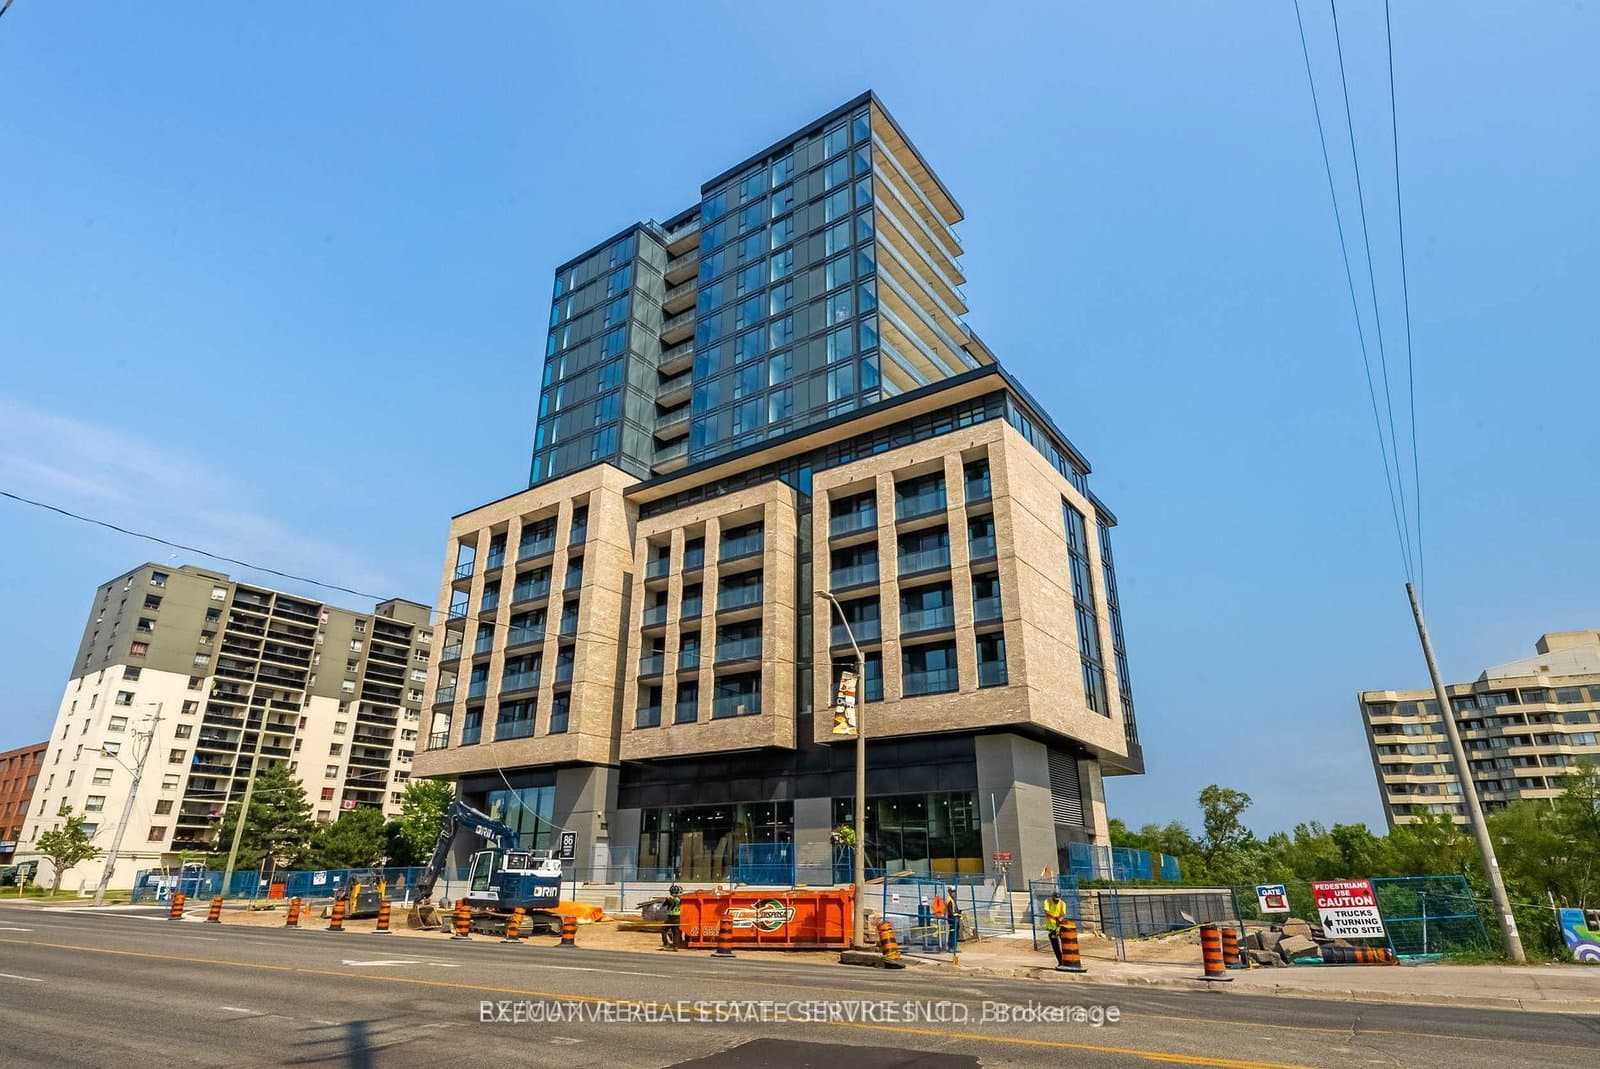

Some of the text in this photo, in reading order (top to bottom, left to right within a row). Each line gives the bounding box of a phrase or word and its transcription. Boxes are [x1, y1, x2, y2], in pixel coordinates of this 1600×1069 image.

[563, 834, 574, 846] 86
[1314, 881, 1369, 890] PEDESTRIANS
[533, 886, 558, 898] ORIN
[1318, 896, 1374, 907] CAUTION
[1334, 909, 1373, 918] TRUCKS
[1335, 918, 1379, 926] TURNING
[1336, 926, 1384, 935] INTO SITE
